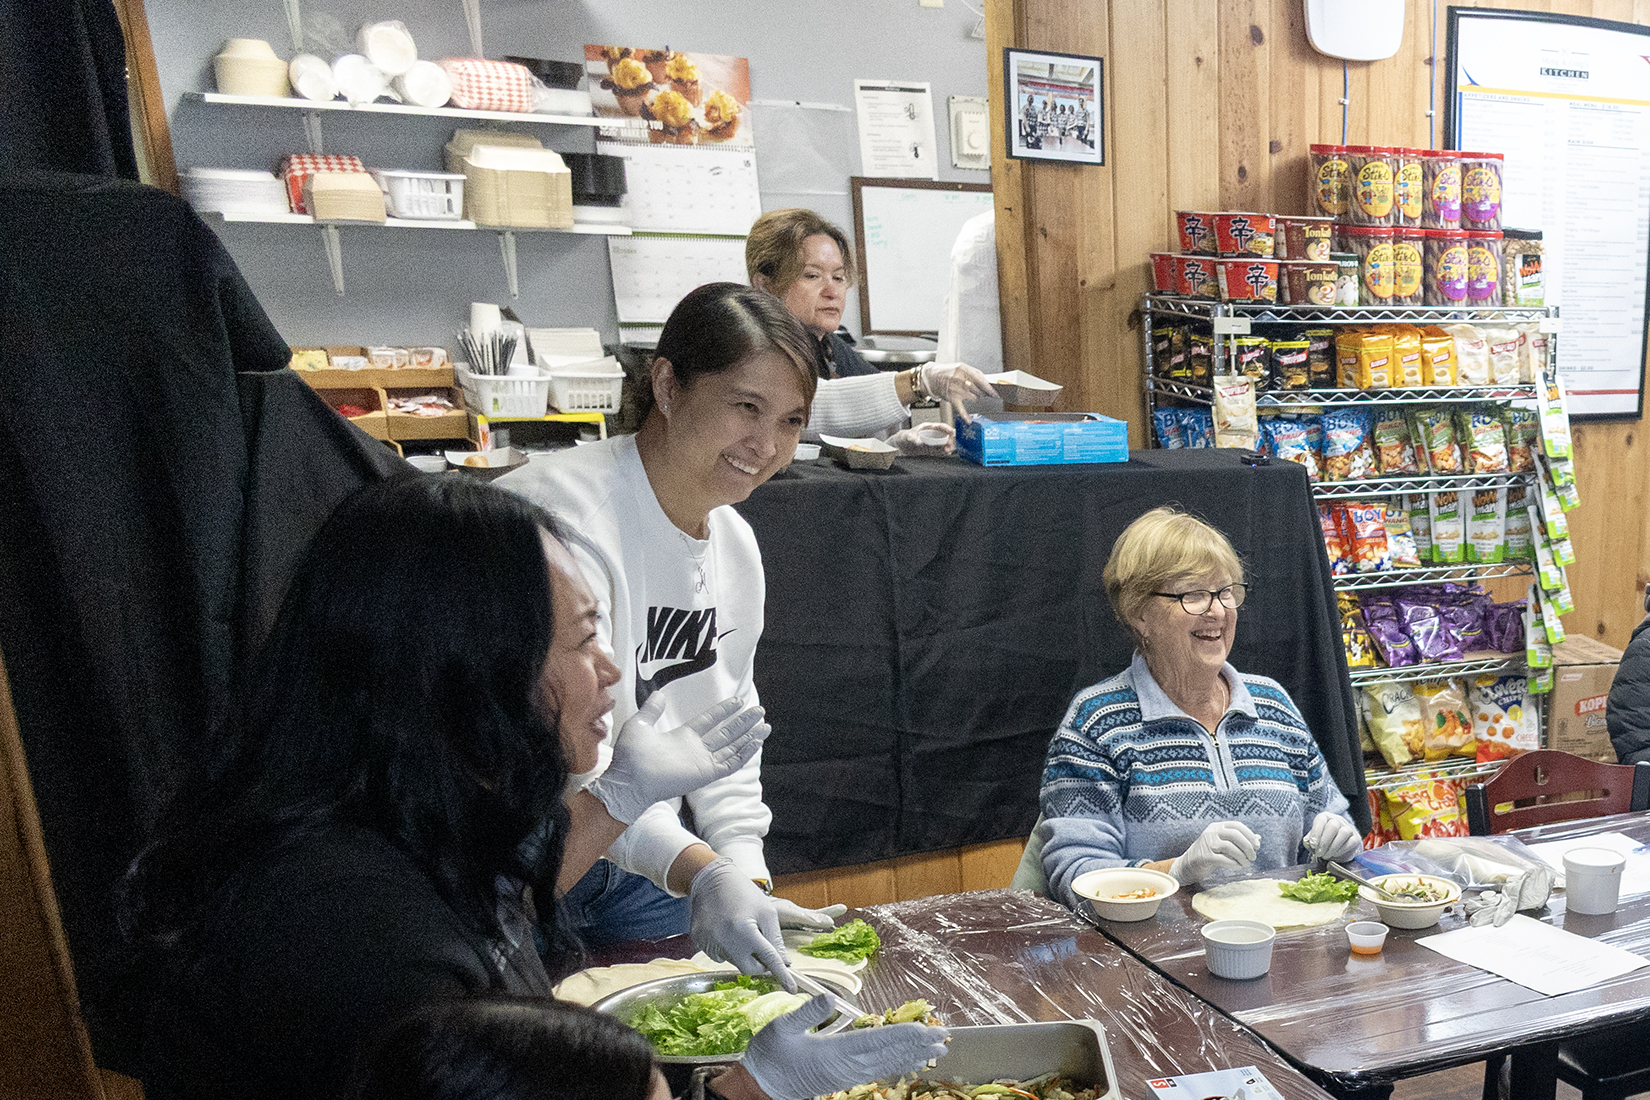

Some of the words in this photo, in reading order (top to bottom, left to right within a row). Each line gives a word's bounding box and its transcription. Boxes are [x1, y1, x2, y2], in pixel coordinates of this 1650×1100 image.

[1541, 67, 1588, 79] KITCHEN
[1185, 217, 1207, 249] 辛
[1231, 217, 1255, 250] 辛
[1185, 262, 1208, 293] 辛
[1247, 264, 1270, 297] 辛
[1471, 414, 1493, 428] BO
[1353, 508, 1381, 524] BOY
[640, 606, 717, 663] NIKE
[1580, 696, 1607, 712] KOPI
